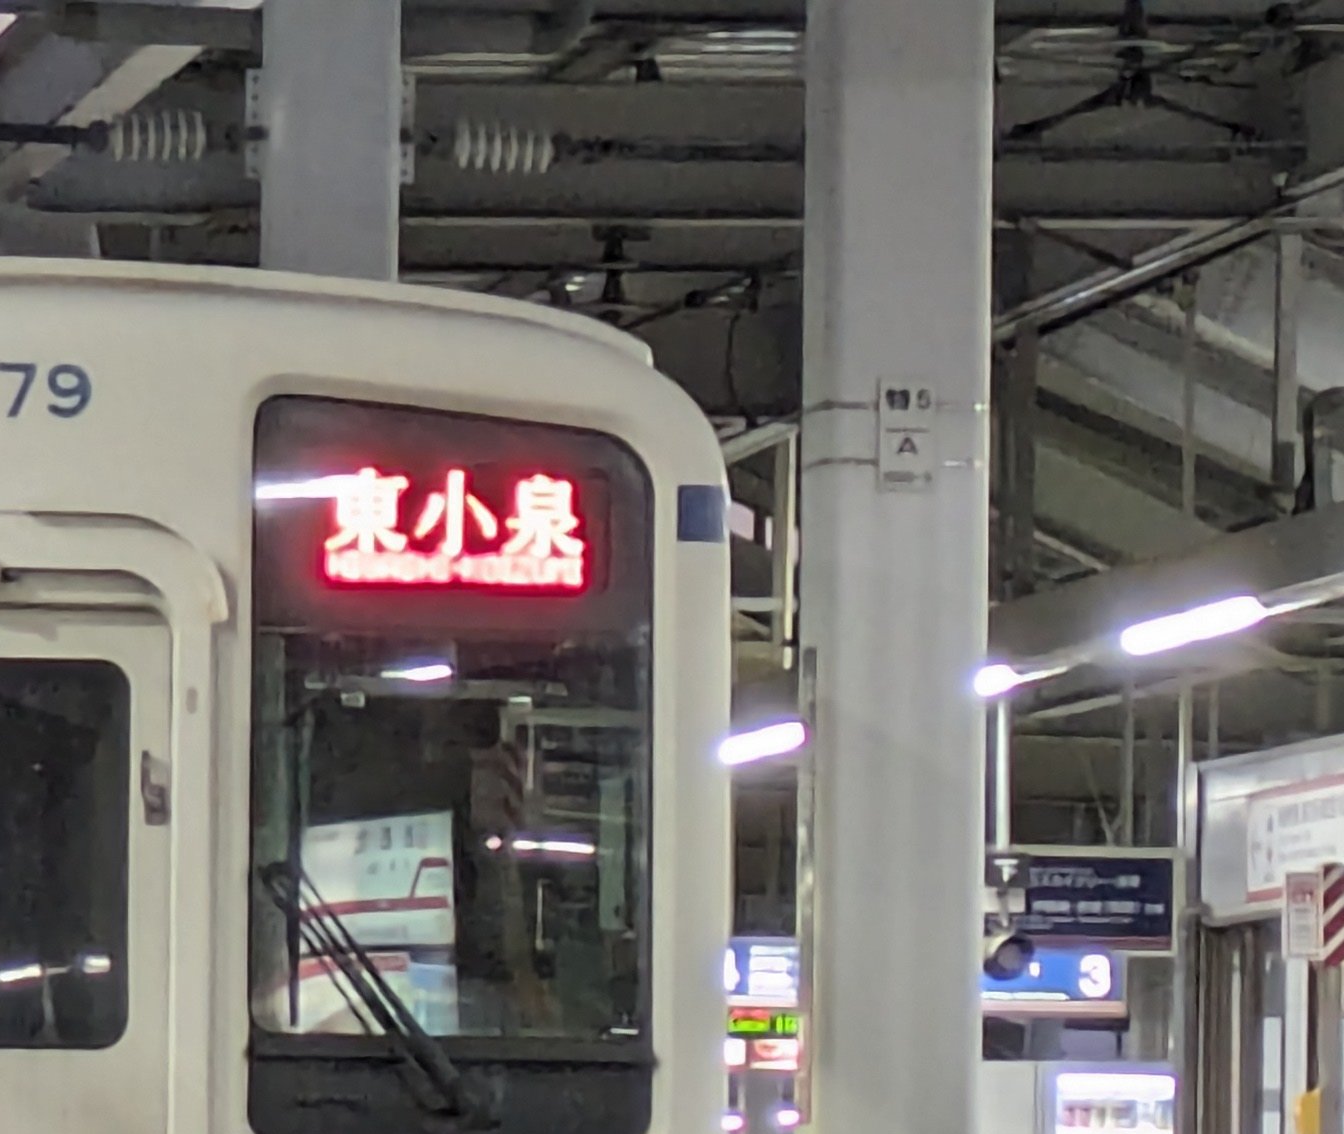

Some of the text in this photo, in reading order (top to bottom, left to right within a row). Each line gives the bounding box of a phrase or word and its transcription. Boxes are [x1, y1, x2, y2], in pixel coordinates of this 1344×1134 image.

[324, 467, 584, 558] 東小泉
[1078, 953, 1112, 998] 3
